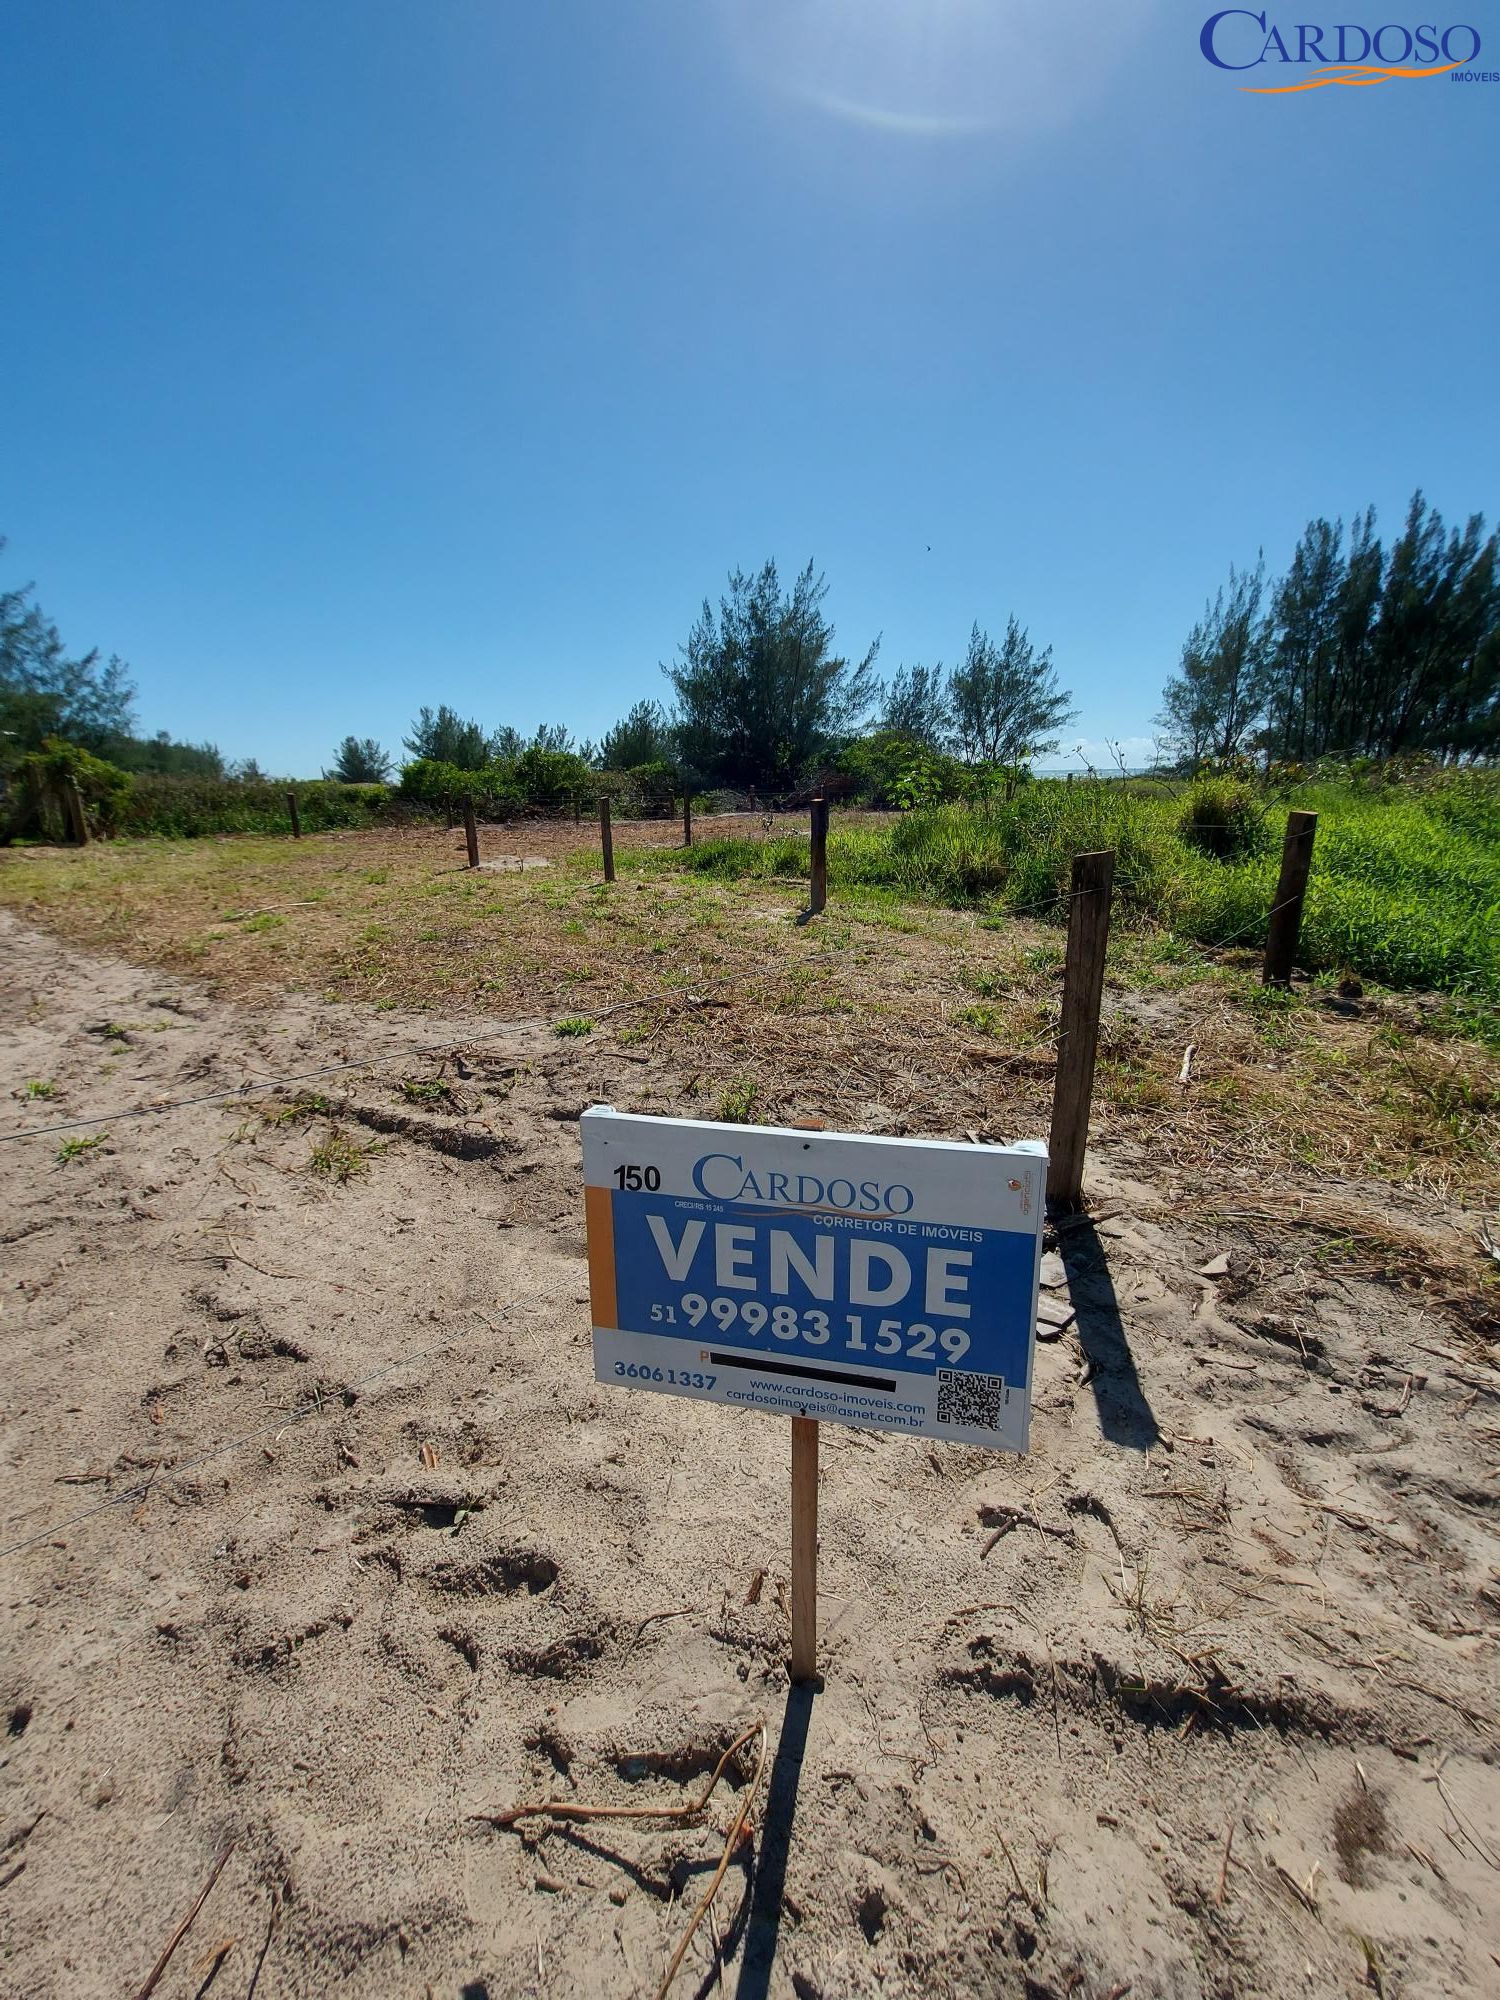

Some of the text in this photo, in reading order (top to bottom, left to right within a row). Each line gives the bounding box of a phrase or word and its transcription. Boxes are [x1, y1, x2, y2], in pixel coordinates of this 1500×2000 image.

[614, 1165, 661, 1192] 150
[692, 1153, 914, 1214] CARDOSO
[813, 1214, 983, 1243] CORRETOR DE IMÓVEIS
[645, 1214, 973, 1319] VENDE
[680, 1293, 830, 1344] 99983
[846, 1315, 971, 1364] 1529
[726, 1389, 924, 1428] cardosoimoveis@asnet.com.br
[750, 1379, 926, 1415] www.cardoso-imoveis.com
